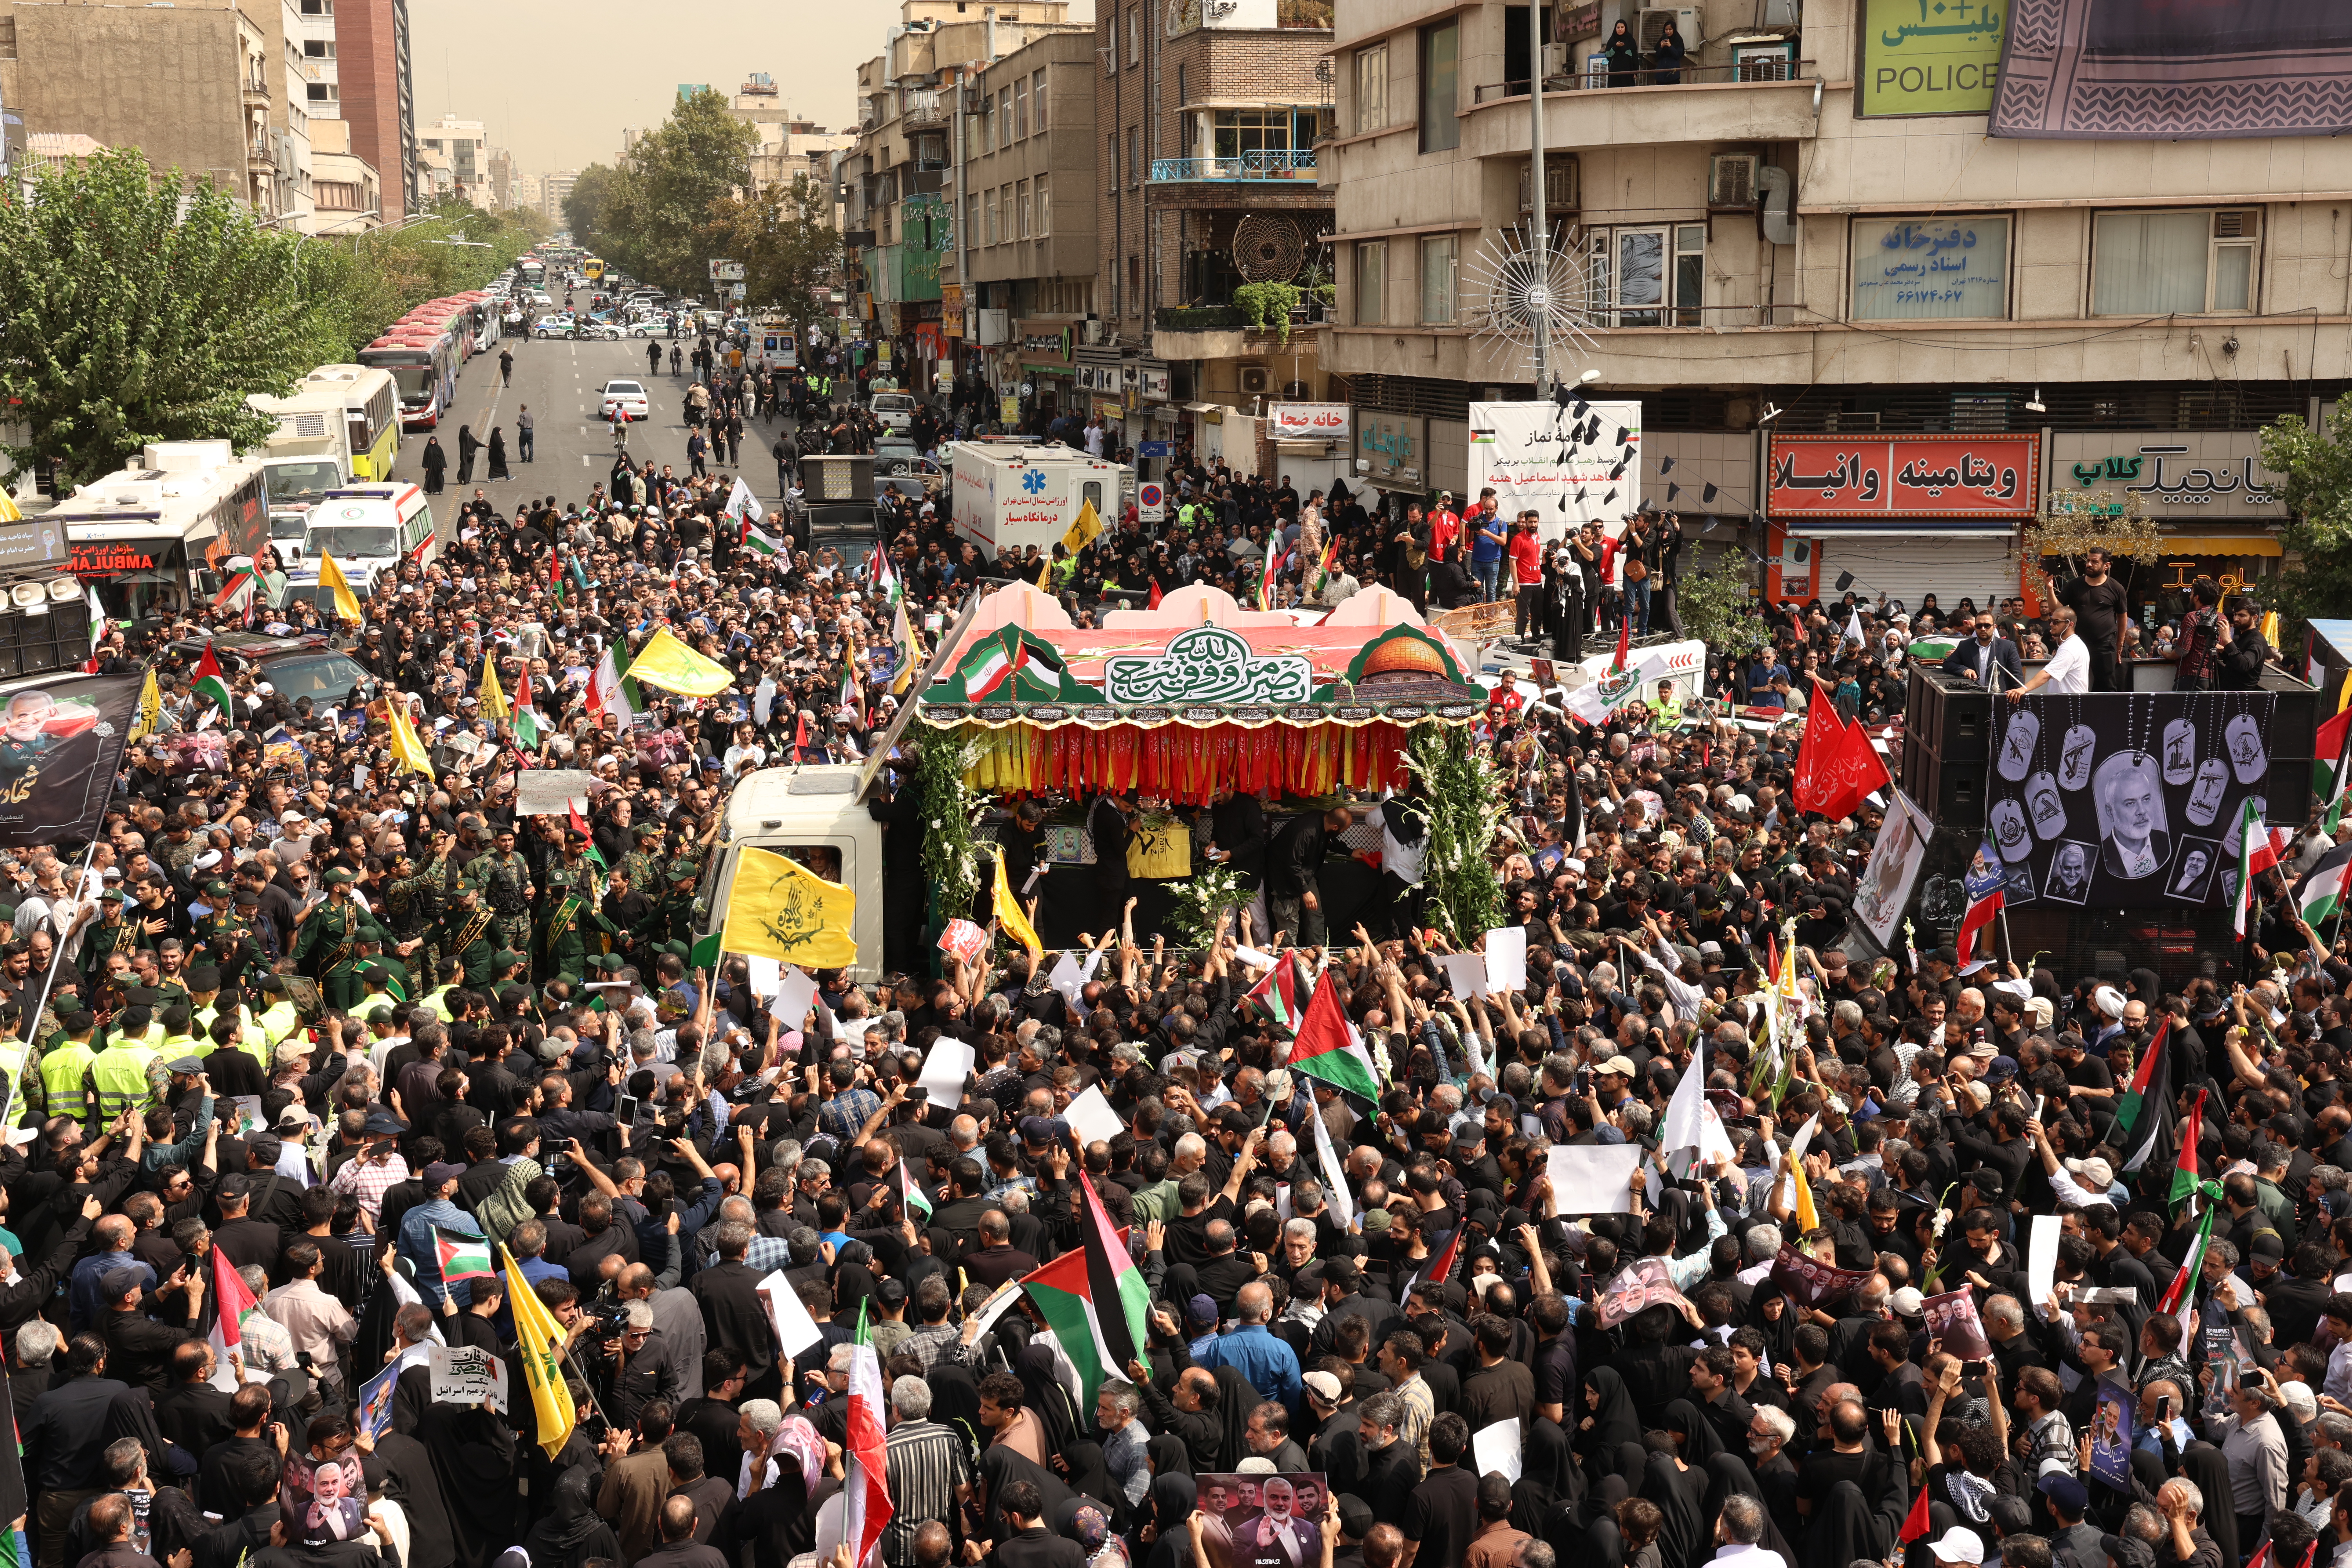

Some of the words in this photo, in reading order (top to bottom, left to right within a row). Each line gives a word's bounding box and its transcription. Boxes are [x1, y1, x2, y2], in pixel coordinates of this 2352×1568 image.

[1882, 4, 2000, 47] پلیس
[1877, 63, 1999, 93] POLICE
[1880, 222, 1976, 256] دفترخانه
[1885, 262, 1926, 276] رسمی
[1931, 256, 1967, 271] اسناد
[1896, 290, 1962, 303] ۶۶۱۷۴۰۶۷
[1280, 411, 1309, 427] ضحا
[1313, 412, 1343, 427] خانه
[1363, 418, 1410, 466] داروخانه
[1525, 430, 1552, 446] نماز
[1494, 457, 1510, 468] پیکر
[1521, 456, 1548, 465] انقلاب
[1597, 457, 1617, 465] توسط
[1488, 473, 1512, 482] هنیه
[1775, 452, 1880, 501] وانیلا
[1897, 452, 2017, 499] ویتامینه
[2072, 456, 2144, 487] کلاب
[1514, 472, 1559, 485] اسماعیل
[1561, 472, 1588, 484] شهید
[1502, 490, 1530, 498] اسلامی
[1002, 496, 1017, 506] تهران
[1017, 496, 1032, 505] استان
[1032, 497, 1046, 506] شمال
[1046, 496, 1067, 506] اورژانس
[1004, 512, 1022, 525] سیار
[1023, 511, 1058, 524] درمانگاه
[8, 533, 21, 541] ناحیه
[7, 547, 17, 556] امام
[19, 544, 35, 554] حضرت
[84, 544, 109, 555] اورژانس
[111, 544, 134, 555] سازمان
[0, 764, 39, 804] شهاد
[2192, 797, 2215, 813] زینبیون
[436, 1385, 465, 1396] اسرائیل
[466, 1387, 486, 1396] ترمیم
[488, 1389, 497, 1399] قابل
[814, 1390, 825, 1405] SNN
[2111, 1475, 2124, 1483] خونخواهی
